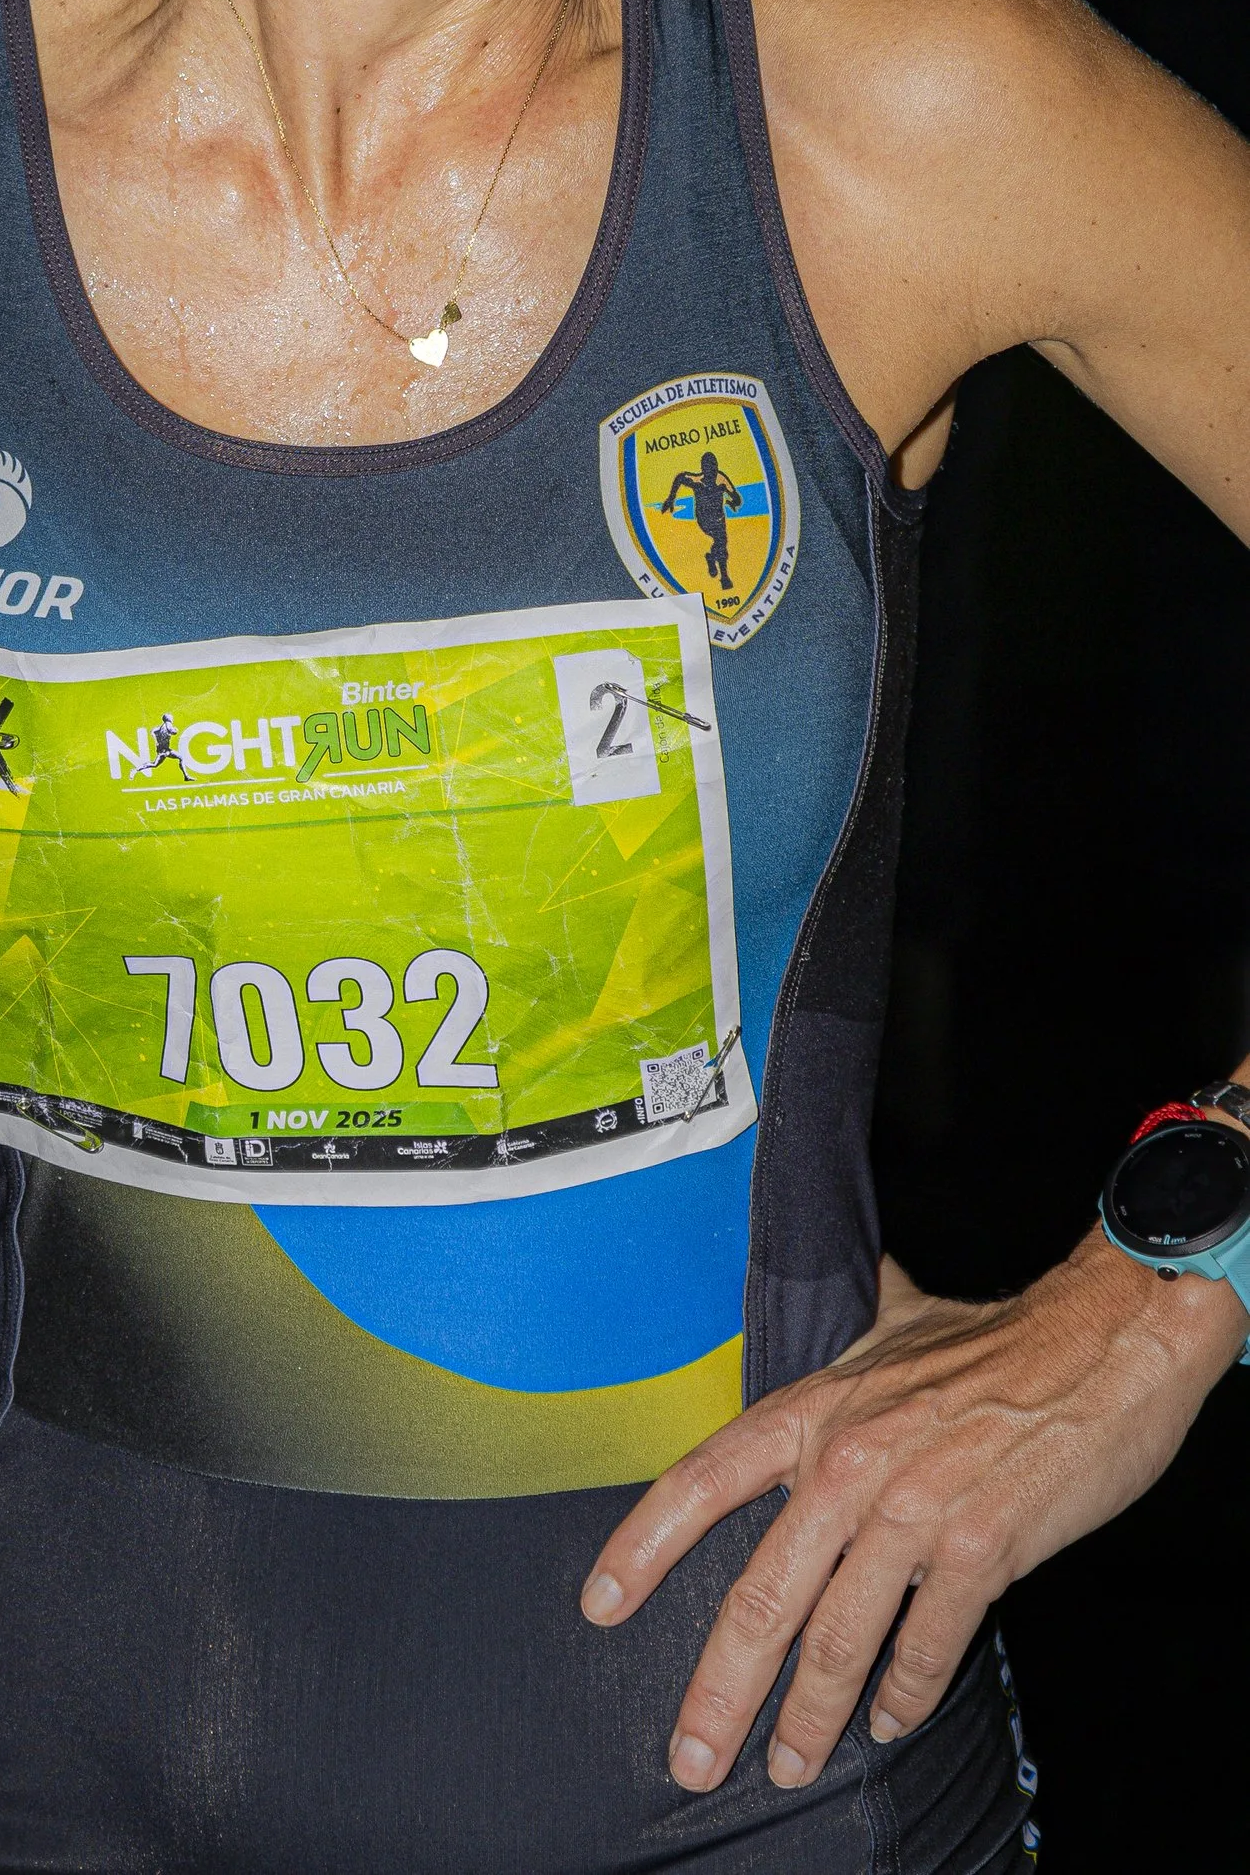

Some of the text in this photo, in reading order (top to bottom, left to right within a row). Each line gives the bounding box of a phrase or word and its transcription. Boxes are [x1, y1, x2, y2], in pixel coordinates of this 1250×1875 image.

[608, 378, 758, 436] ESCUELA DE ATLETISMO
[644, 419, 742, 455] MORRO JABLE
[340, 679, 425, 706] Binter
[589, 682, 634, 759] 2
[144, 780, 407, 813] LAS PALMAS DE GRAN CANARIA
[122, 948, 501, 1092] 7032
[250, 1109, 403, 1131] 1 NOV 2025
[397, 1147, 434, 1156] Canarias
[413, 1140, 433, 1149] Islas
